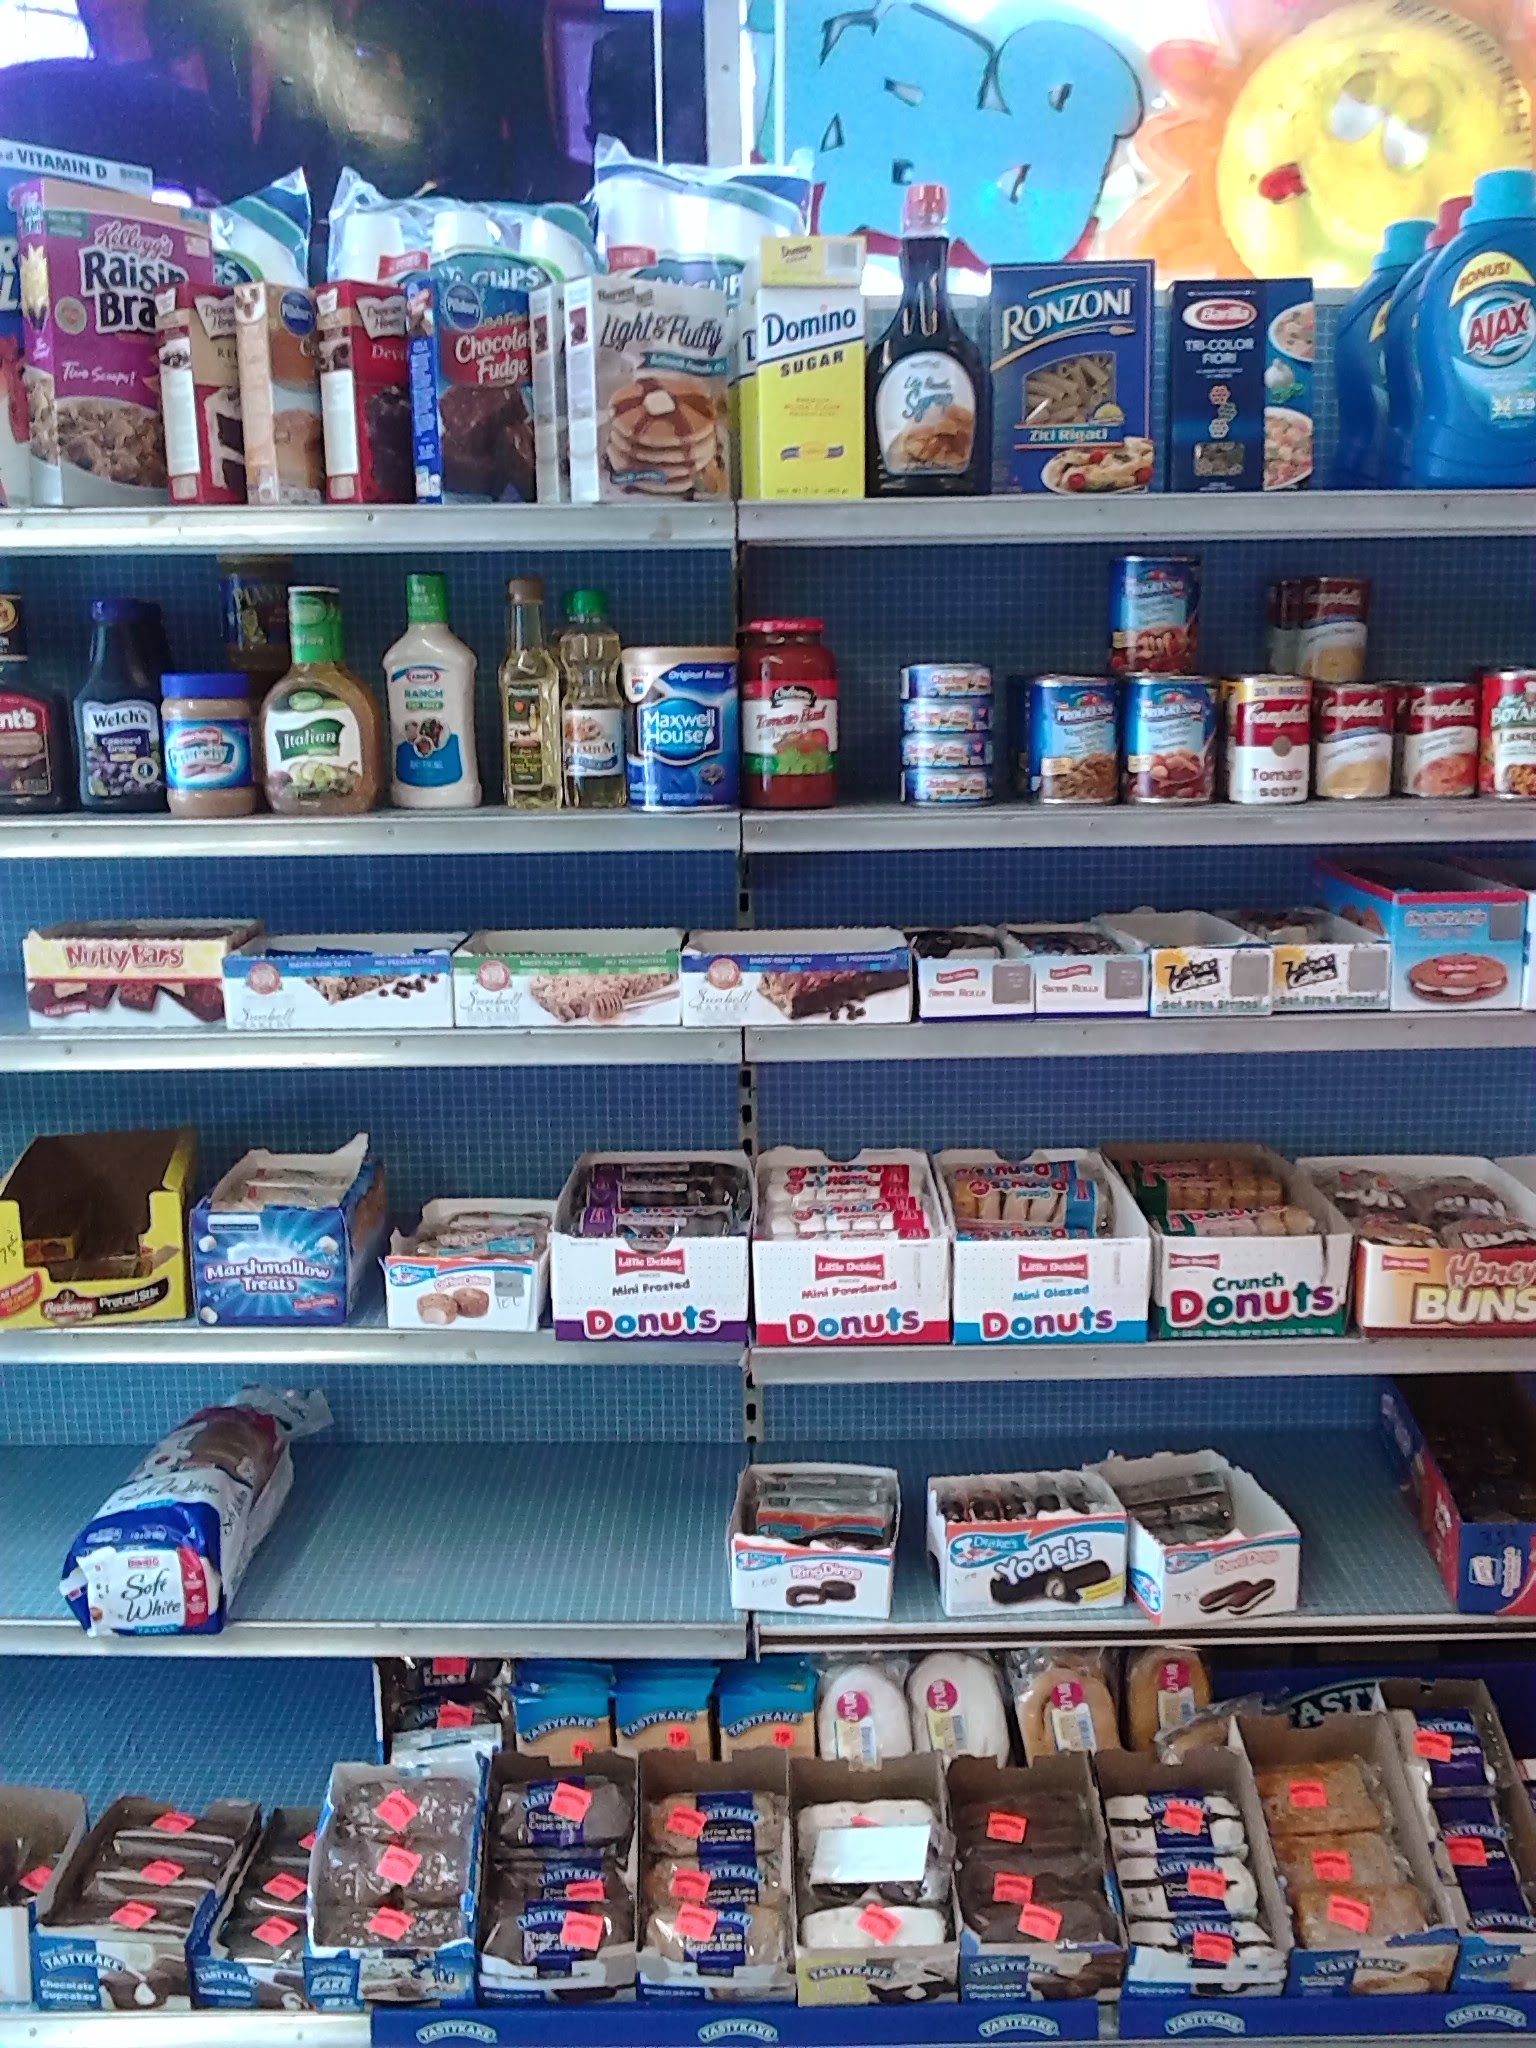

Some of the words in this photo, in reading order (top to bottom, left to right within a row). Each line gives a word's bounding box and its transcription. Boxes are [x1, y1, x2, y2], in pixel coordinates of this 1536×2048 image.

[16, 148, 90, 176] VITAMIN
[95, 164, 107, 179] D
[94, 221, 174, 259] Kellogg's
[83, 252, 187, 290] Raisin
[100, 294, 156, 330] Bra
[1002, 288, 1132, 349] RONZONI
[601, 312, 654, 351] Light
[653, 316, 668, 339] &
[667, 314, 723, 357] Fluffy
[763, 303, 857, 347] Domino
[1467, 302, 1527, 350] AJAX
[456, 327, 533, 364] Chocola
[62, 360, 90, 381] Two
[477, 355, 530, 388] Fudge
[780, 350, 845, 378] SUGAR
[403, 689, 443, 699] RANCH
[0, 707, 37, 730] nt's
[92, 709, 149, 729] Welch's
[643, 709, 715, 730] Maxwell
[756, 713, 799, 729] Tomato
[284, 727, 337, 750] Italian
[645, 728, 704, 746] House
[1259, 786, 1298, 797] SOUP
[64, 943, 129, 973] Nutty
[129, 943, 184, 968] Bars
[1164, 957, 1219, 979] Zebra
[1281, 952, 1336, 975] Zebra
[206, 1258, 331, 1280] Marshmallow
[1447, 1252, 1536, 1290] Honey
[242, 1277, 295, 1292] Treats
[612, 1284, 638, 1297] Mini
[642, 1279, 691, 1294] Frosted
[801, 1287, 829, 1299] Mini
[832, 1280, 898, 1297] Powdered
[1044, 1284, 1090, 1299] Glazed
[1212, 1272, 1284, 1292] Crunch
[1170, 1281, 1334, 1323] Donuts
[1415, 1286, 1536, 1323] BUNS
[586, 1304, 717, 1335] Donuts
[788, 1306, 920, 1338] Donuts
[982, 1306, 1113, 1338] Donuts
[994, 1536, 1092, 1585] Yodels
[121, 1568, 170, 1600] Soft
[126, 1598, 182, 1622] White
[524, 1715, 596, 1742] TASTYKAKE
[623, 1710, 696, 1737] TASTYKAKE
[727, 1711, 801, 1738] TASTYKAKE
[706, 1807, 763, 1825] STYKAKE
[45, 1951, 124, 1971] TASTYKAKE
[809, 1965, 894, 1980] TASTYKAKE
[973, 1960, 1055, 1977] TASTYKAKE
[39, 1979, 95, 1991] Chocolate
[199, 1971, 258, 1987] TASTYKAKE
[42, 1990, 98, 2001] Cupcakes
[982, 2015, 1058, 2036] TASTYKAKE
[1166, 2013, 1245, 2034] TASTYKAKE
[1447, 2005, 1525, 2027] TASTYKAKE
[418, 2022, 496, 2044] TASTYKAKE
[700, 2019, 778, 2040] TASTYKAKE
